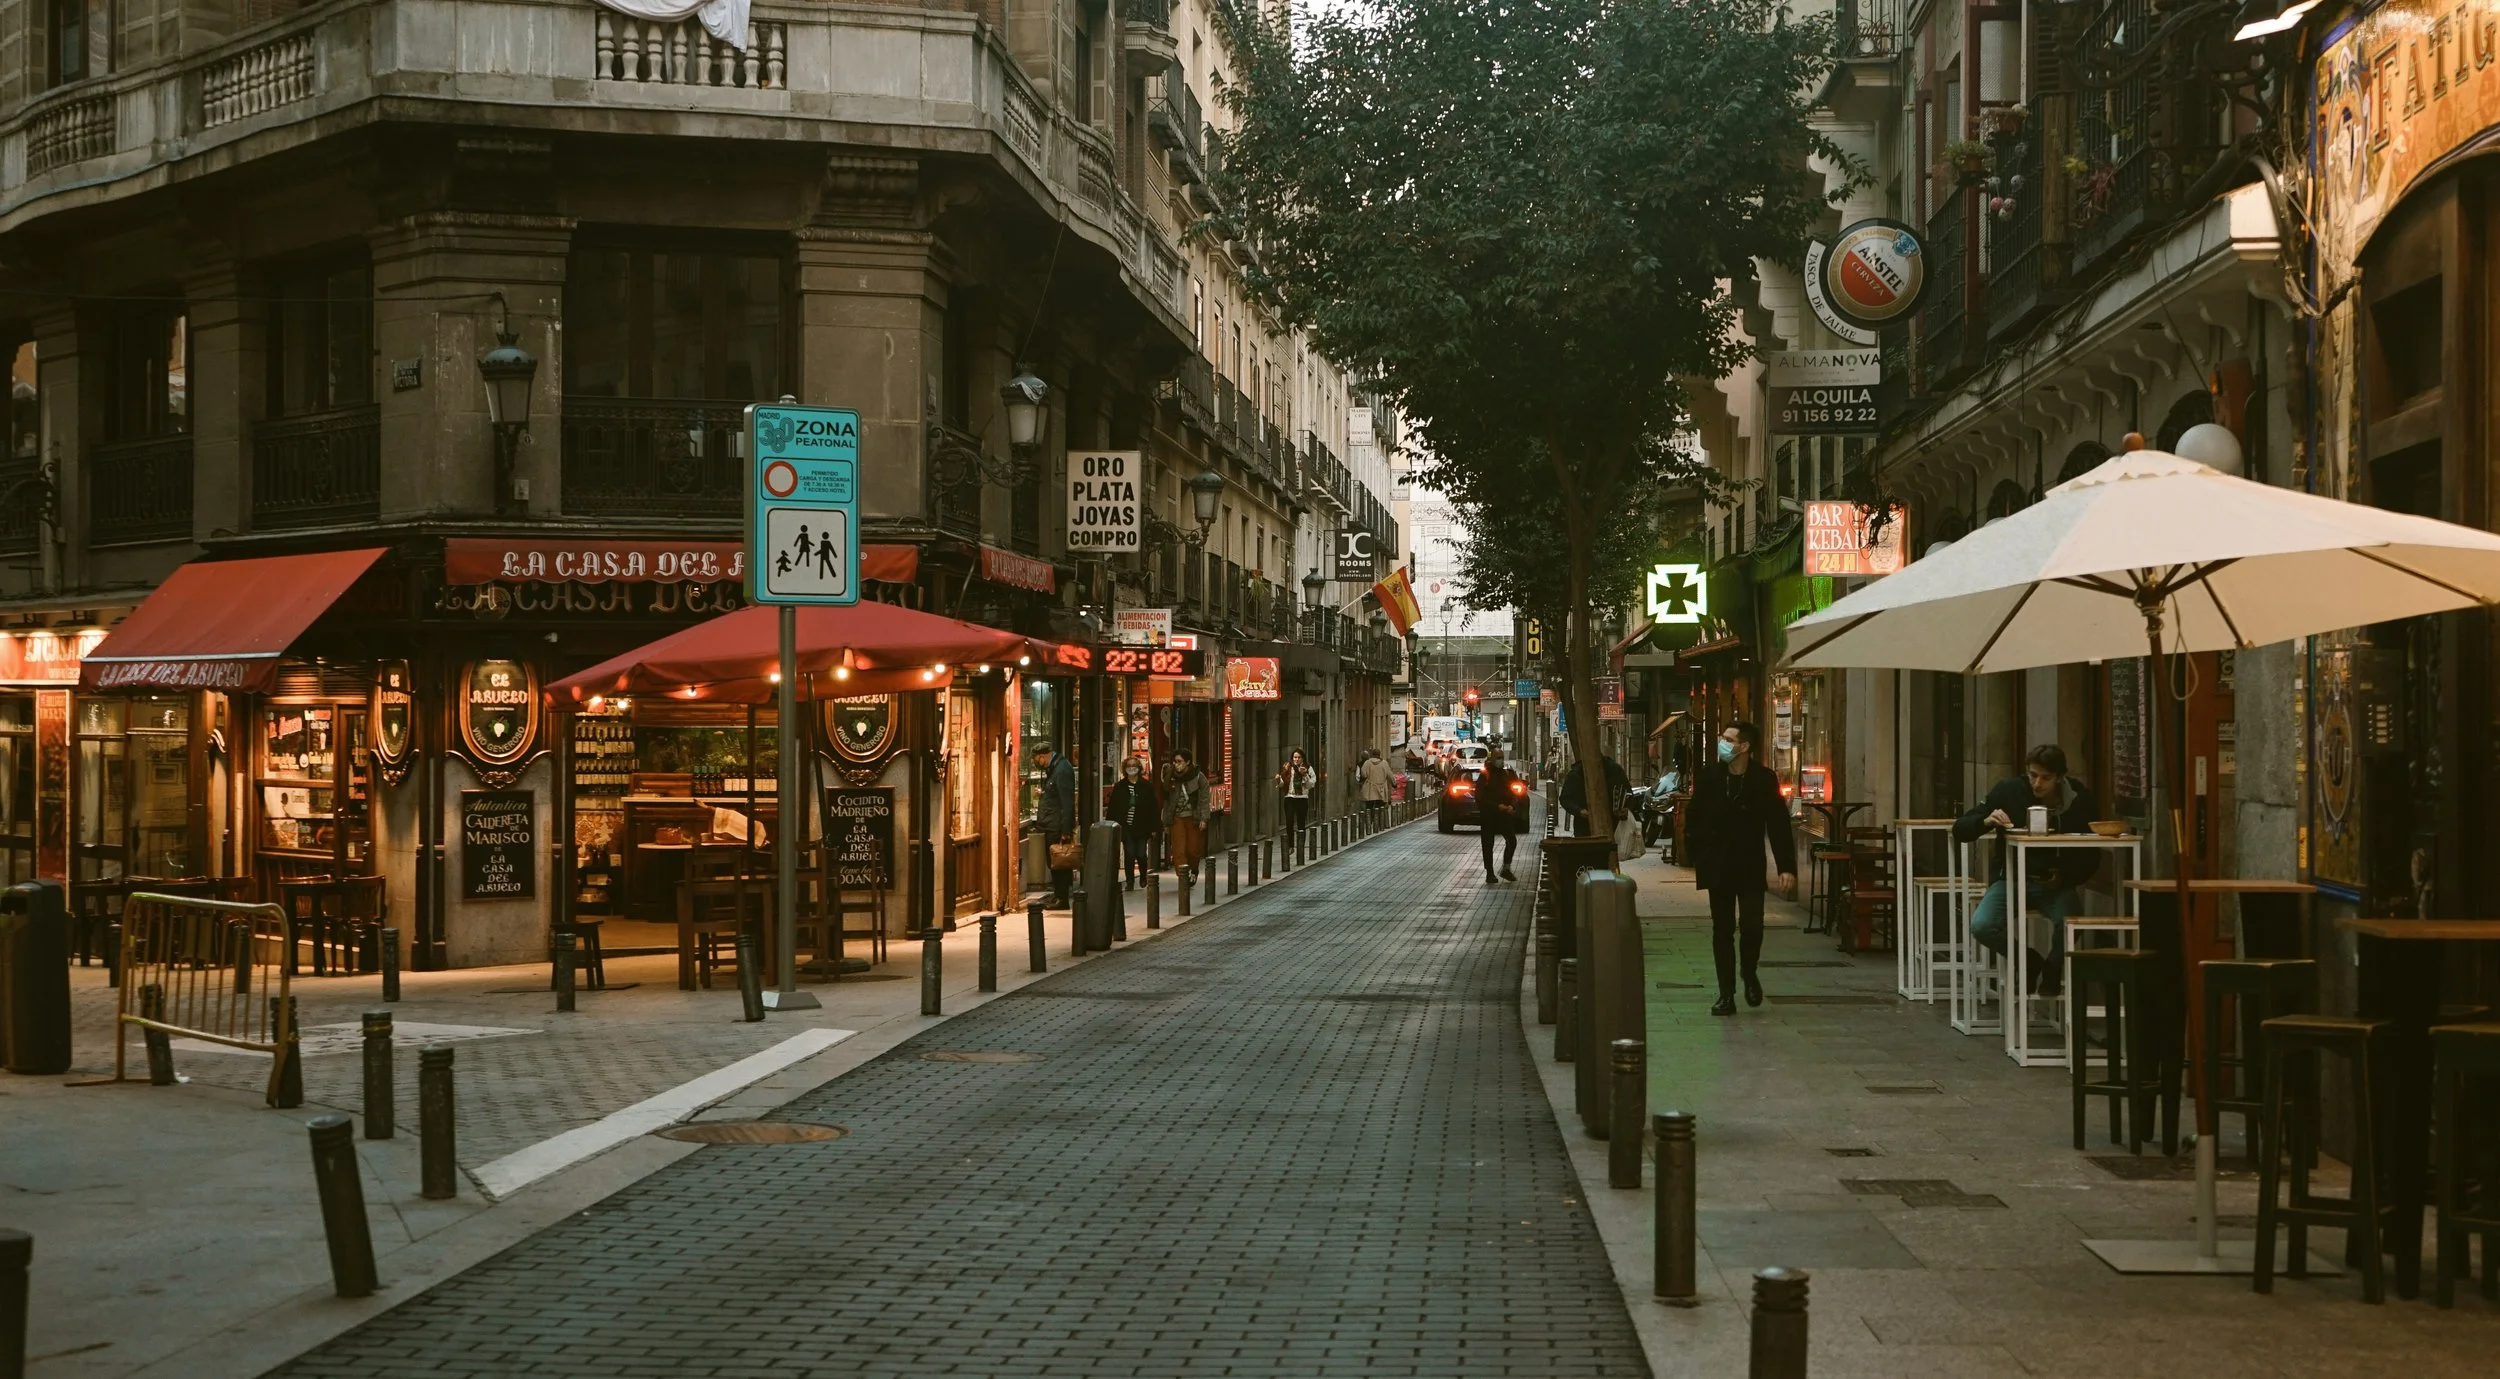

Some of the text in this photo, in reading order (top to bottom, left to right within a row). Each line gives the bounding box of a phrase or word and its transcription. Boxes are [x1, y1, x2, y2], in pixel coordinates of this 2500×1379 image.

[1858, 246, 1904, 292] AMSTEL
[1851, 261, 1885, 297] CERVEZA
[1806, 252, 1857, 341] TASCA DE JAIME
[1779, 353, 1880, 369] ALMANOVA
[1788, 388, 1873, 407] ALQUILA
[759, 412, 780, 420] MADRID
[1782, 407, 1877, 422] 91 156 92 22
[795, 420, 856, 437] ZONA
[796, 437, 856, 449] PEATONAL
[1083, 457, 1124, 477] ORO
[1073, 482, 1134, 501] PLATA
[1072, 506, 1134, 526] JOYAS
[1809, 505, 1846, 527] BAR
[1070, 530, 1137, 546] COMPRO
[1339, 532, 1371, 559] JC
[1807, 528, 1867, 551] KEBAB
[501, 551, 546, 578] LA
[555, 551, 646, 578] CASA
[653, 551, 720, 578] DEL
[1819, 553, 1856, 572] 24 H
[514, 582, 633, 613] CASA
[649, 582, 738, 613] DEL
[1117, 612, 1167, 621] ALIMENTACION
[1117, 621, 1151, 630] Y BEBIDAS
[1105, 650, 1183, 674] 22:02
[98, 664, 117, 686] LA
[117, 663, 151, 684] CASA
[150, 663, 180, 684] DEL
[181, 662, 245, 687] ABUELO
[490, 673, 510, 688] EL
[470, 689, 528, 704] ABUELO
[473, 725, 525, 752] VINO GENEROSO
[837, 725, 886, 751] VINO GENEROSO
[837, 794, 885, 806] COCIDITO
[466, 813, 529, 829] CALDERETA
[853, 825, 867, 833] LA
[467, 831, 530, 845] MARISCO
[845, 834, 874, 843] CASA
[850, 843, 870, 852] DEL
[490, 854, 506, 864] LA
[482, 864, 513, 873] CASA
[487, 873, 510, 883] DEL
[475, 882, 521, 893] ABUELO
